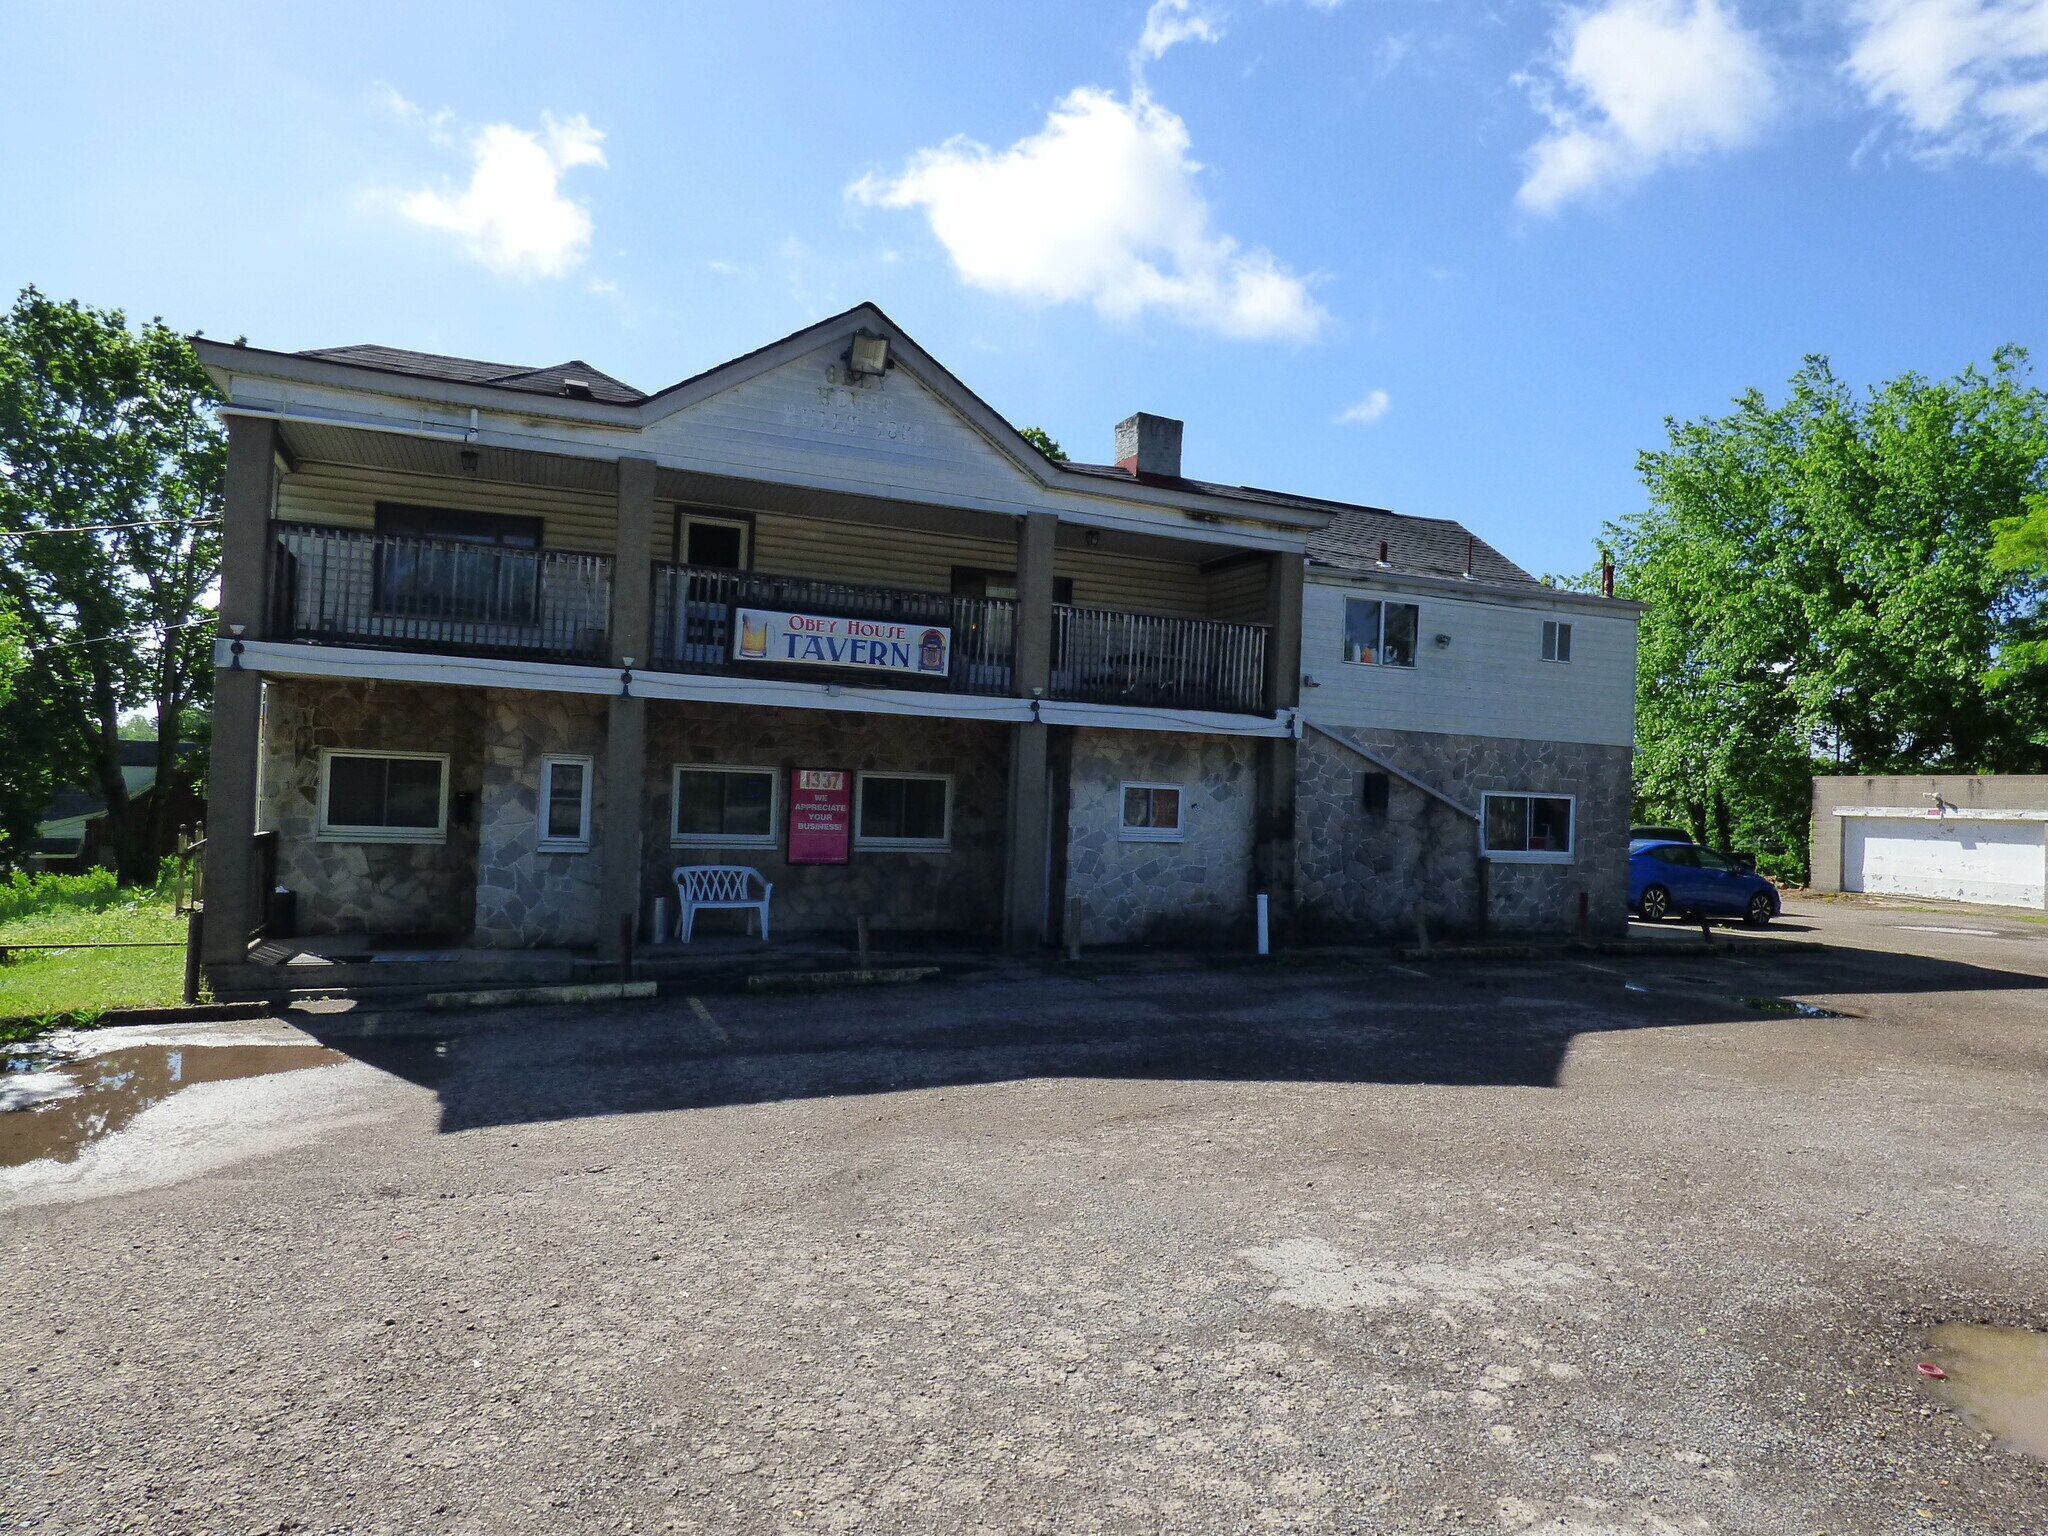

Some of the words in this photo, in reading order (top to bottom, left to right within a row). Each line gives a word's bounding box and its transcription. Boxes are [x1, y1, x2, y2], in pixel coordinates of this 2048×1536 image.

[789, 616, 837, 633] OBEY
[848, 621, 905, 639] HOUSE
[783, 633, 910, 667] TAVERN
[805, 773, 840, 788] 1337
[795, 803, 846, 811] APPRECIATE
